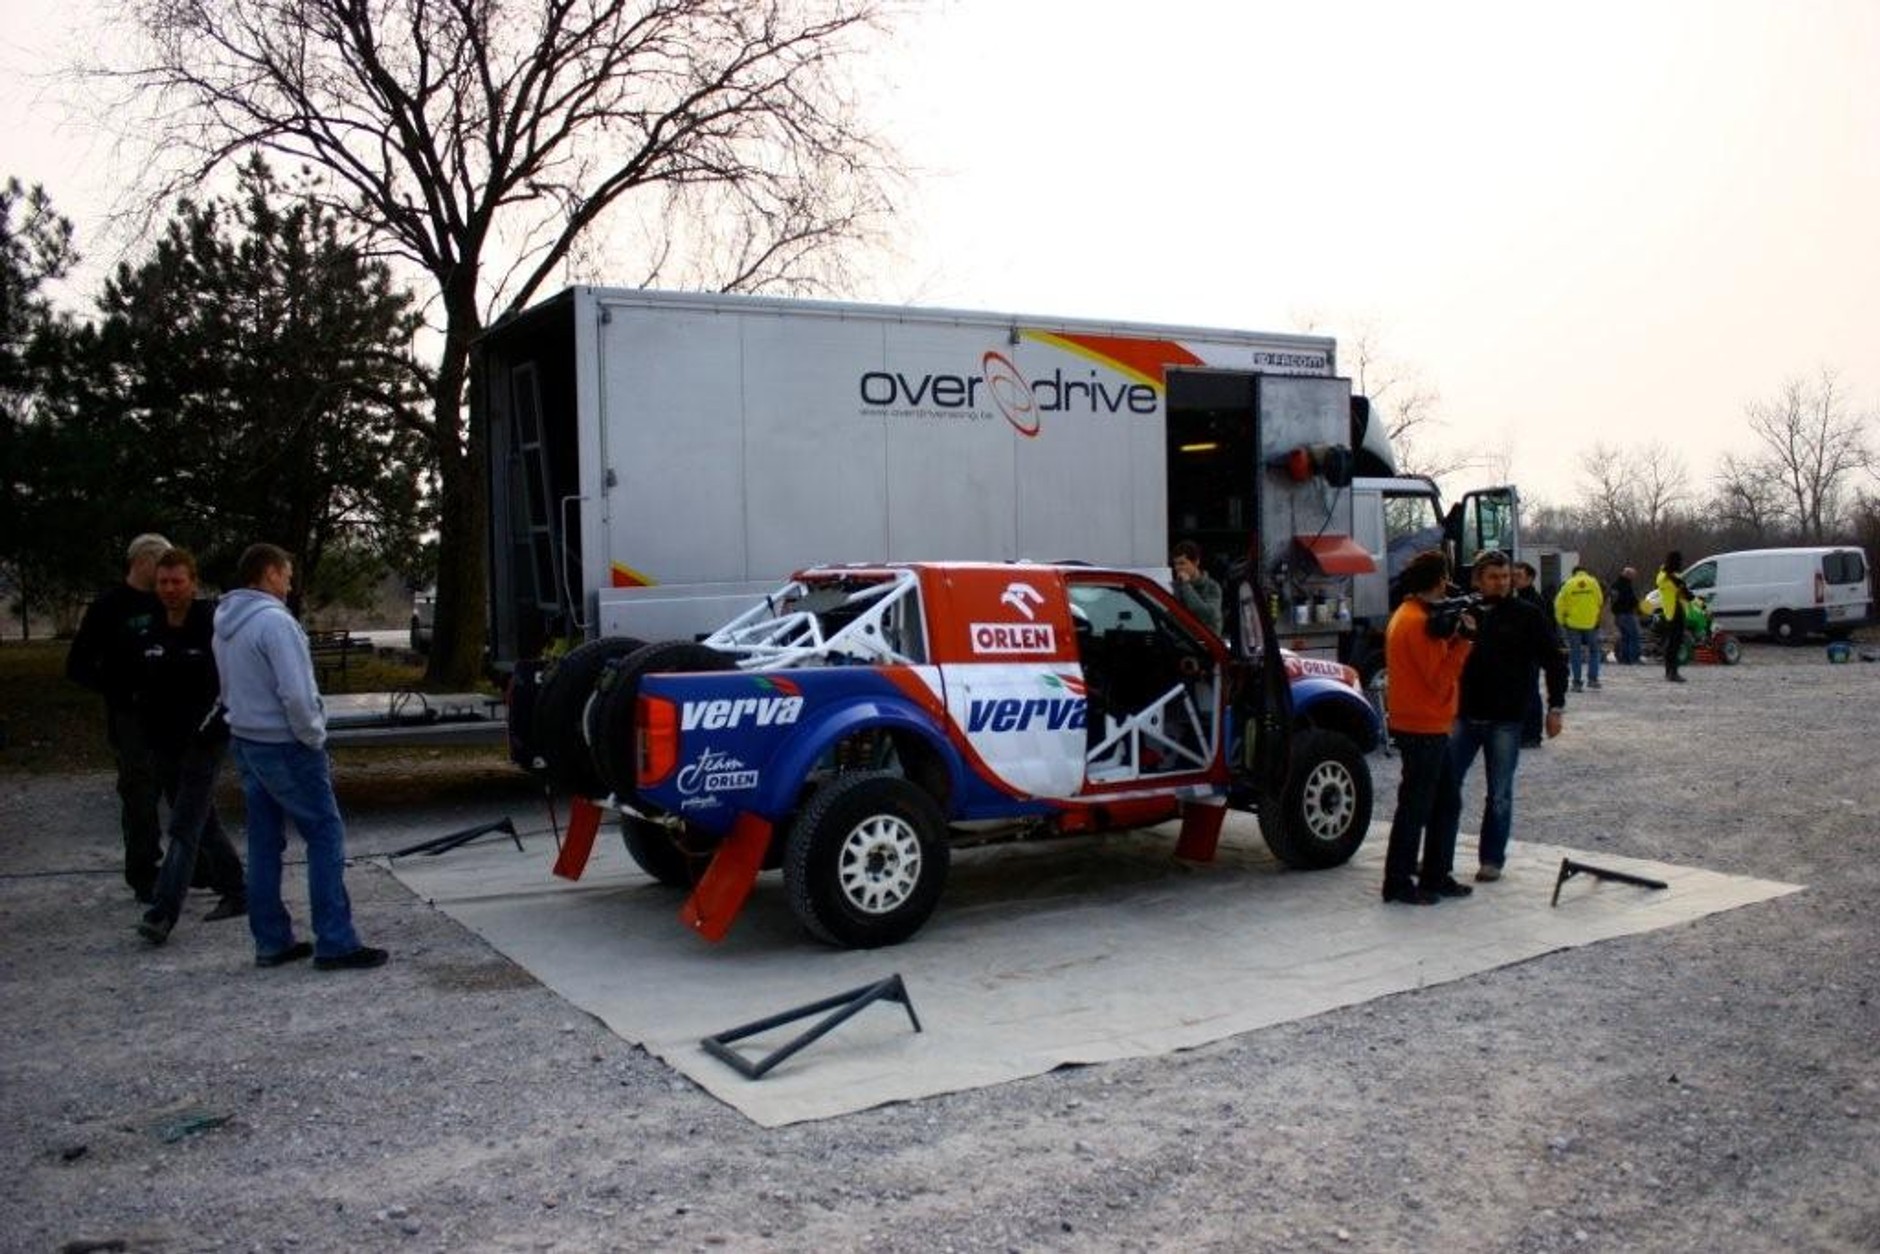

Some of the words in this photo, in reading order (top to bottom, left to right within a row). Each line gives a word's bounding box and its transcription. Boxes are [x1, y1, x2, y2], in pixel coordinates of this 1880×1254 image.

[860, 371, 984, 408] over
[1031, 367, 1158, 415] drive
[976, 627, 1050, 650] ORLEN
[680, 696, 804, 731] verva
[707, 773, 756, 788] ORLEN
